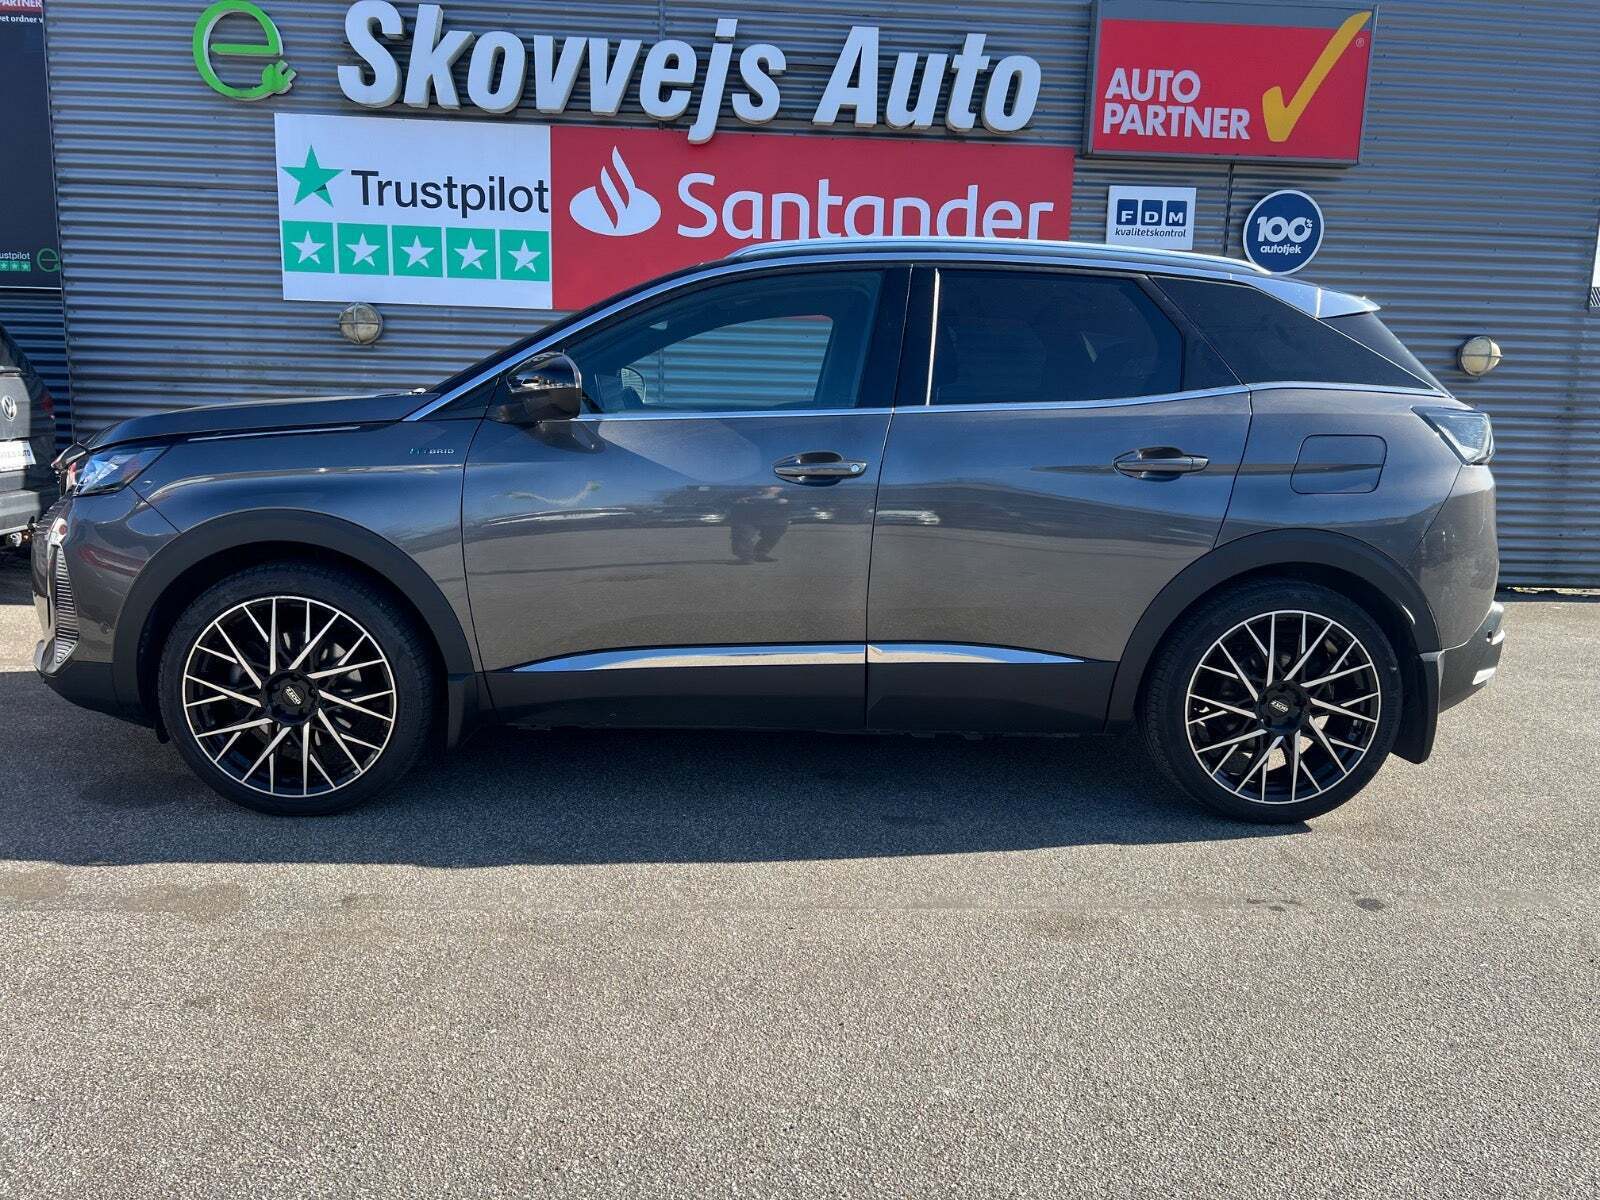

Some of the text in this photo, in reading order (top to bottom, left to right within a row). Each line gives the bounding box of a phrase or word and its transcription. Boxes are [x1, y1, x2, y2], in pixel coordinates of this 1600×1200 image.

[338, 0, 1042, 144] Skovvejs Auto
[1104, 67, 1201, 103] AUTO
[1102, 102, 1251, 140] PARTNER
[351, 169, 549, 219] Trustpilot
[677, 172, 1054, 241] Santander
[1114, 227, 1186, 238] kvalitetskontrol
[1121, 209, 1184, 224] FDM
[1260, 244, 1302, 256] autotjek
